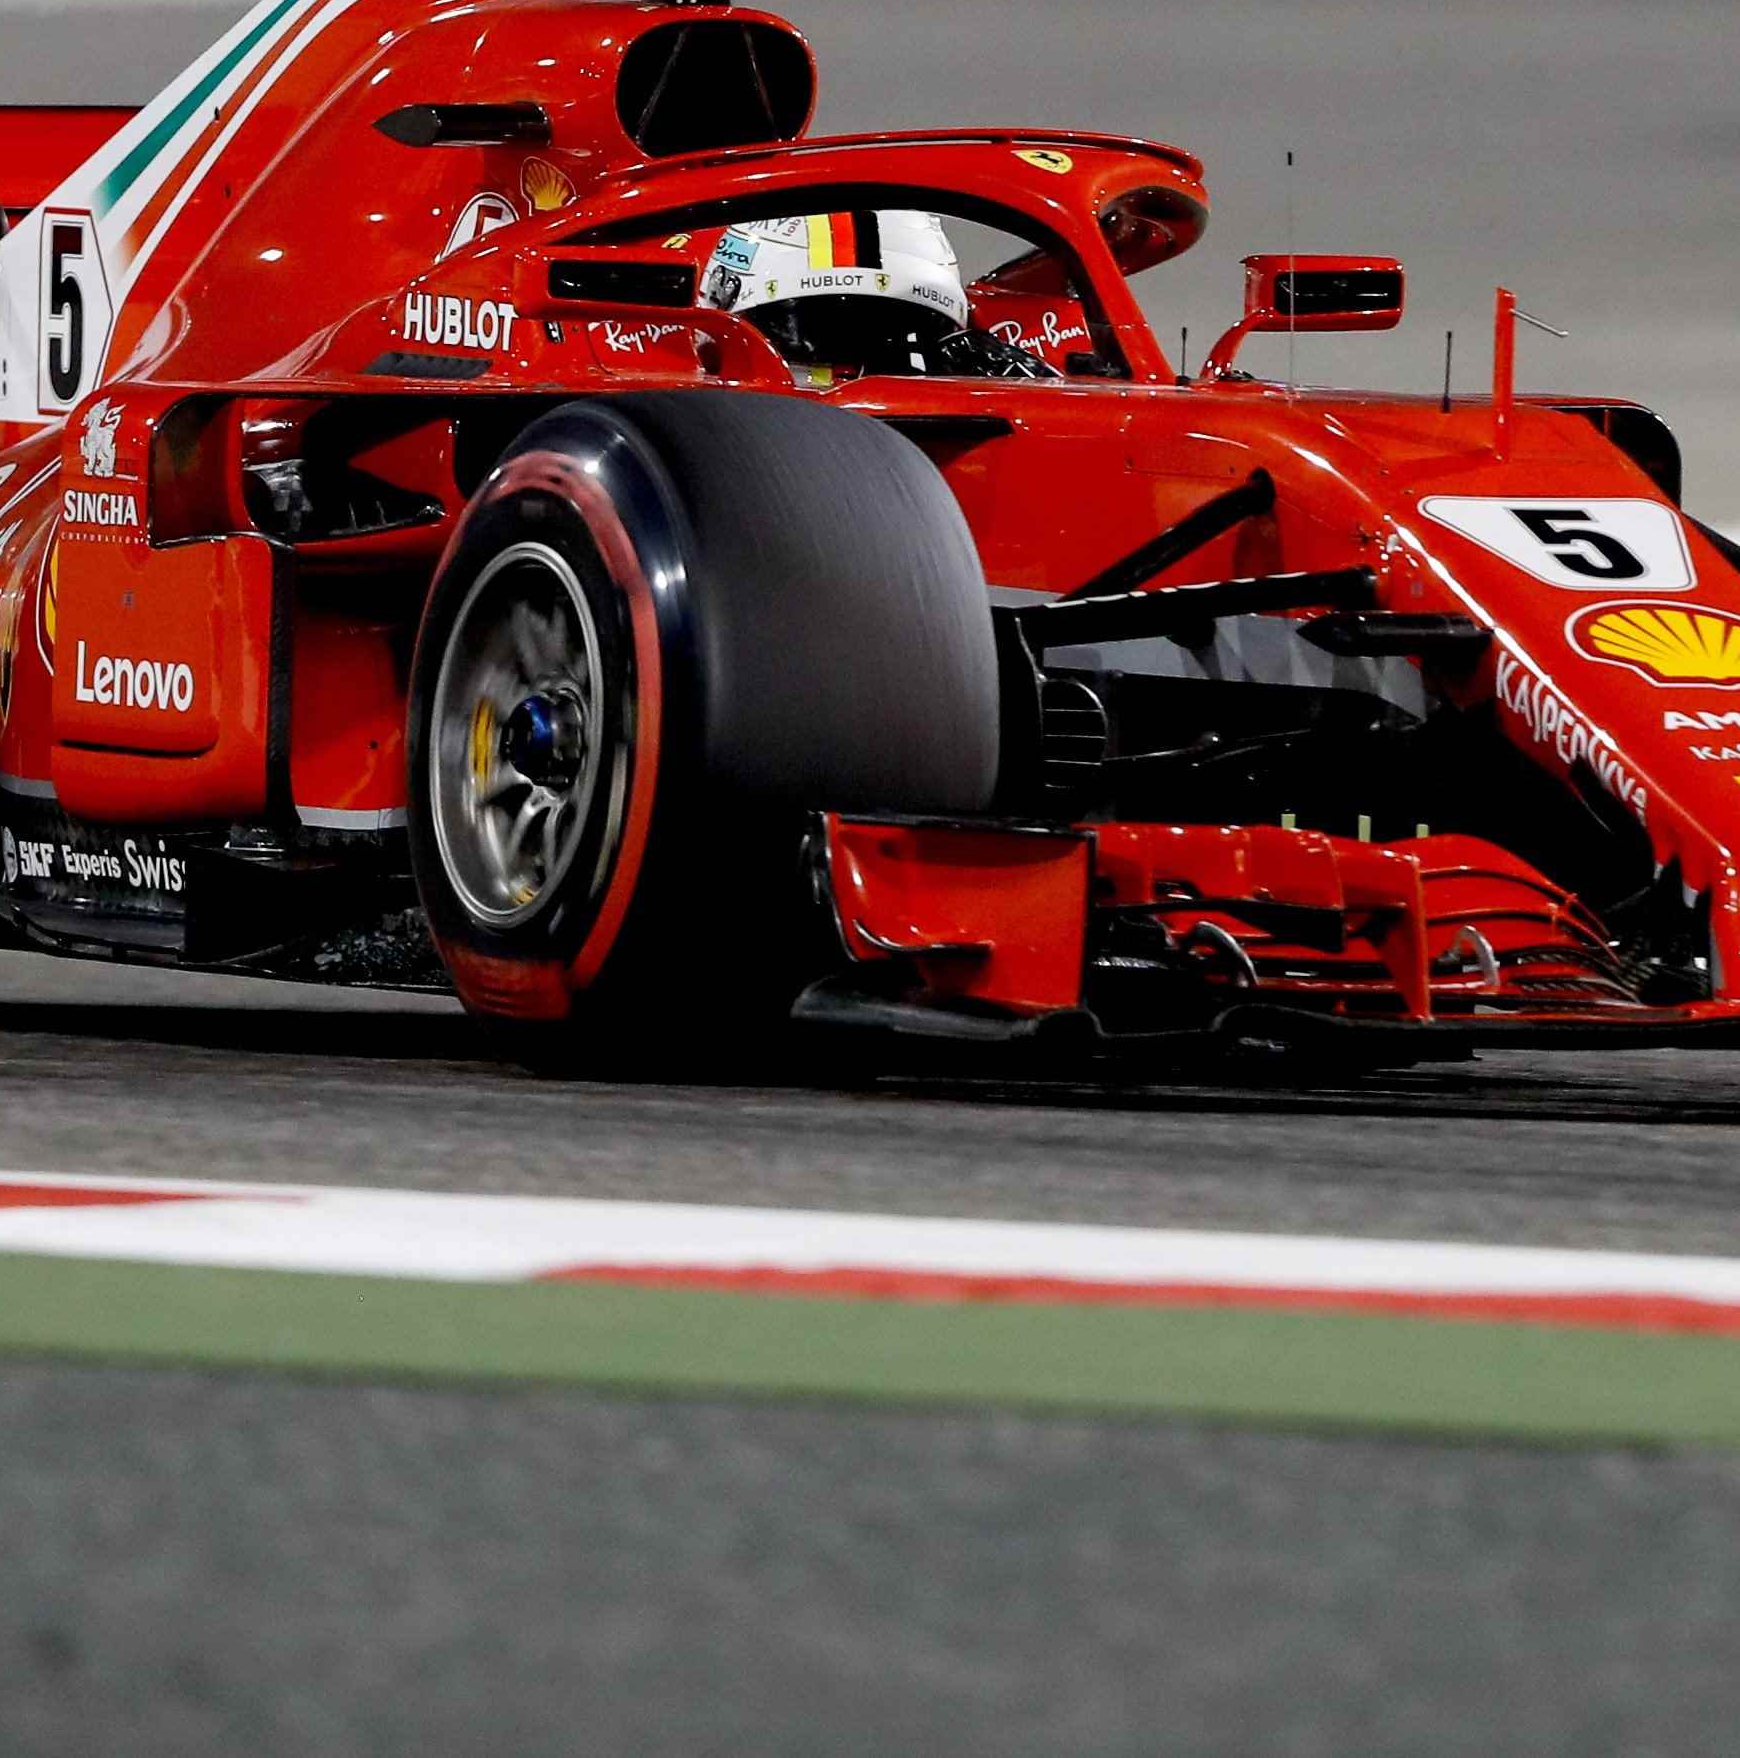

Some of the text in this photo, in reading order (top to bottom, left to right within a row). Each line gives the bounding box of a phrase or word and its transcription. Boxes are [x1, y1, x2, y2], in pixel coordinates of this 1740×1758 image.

[800, 275, 864, 289] HUBLOT
[912, 284, 956, 309] HUBLOT
[48, 225, 84, 401] 5
[402, 292, 517, 351] HUBLOT
[62, 489, 139, 527] SINGHA
[1509, 508, 1645, 580] 5
[76, 640, 195, 712] Lenovo
[18, 840, 55, 878] SKF
[61, 844, 122, 881] Experis
[123, 839, 186, 892] Swis
